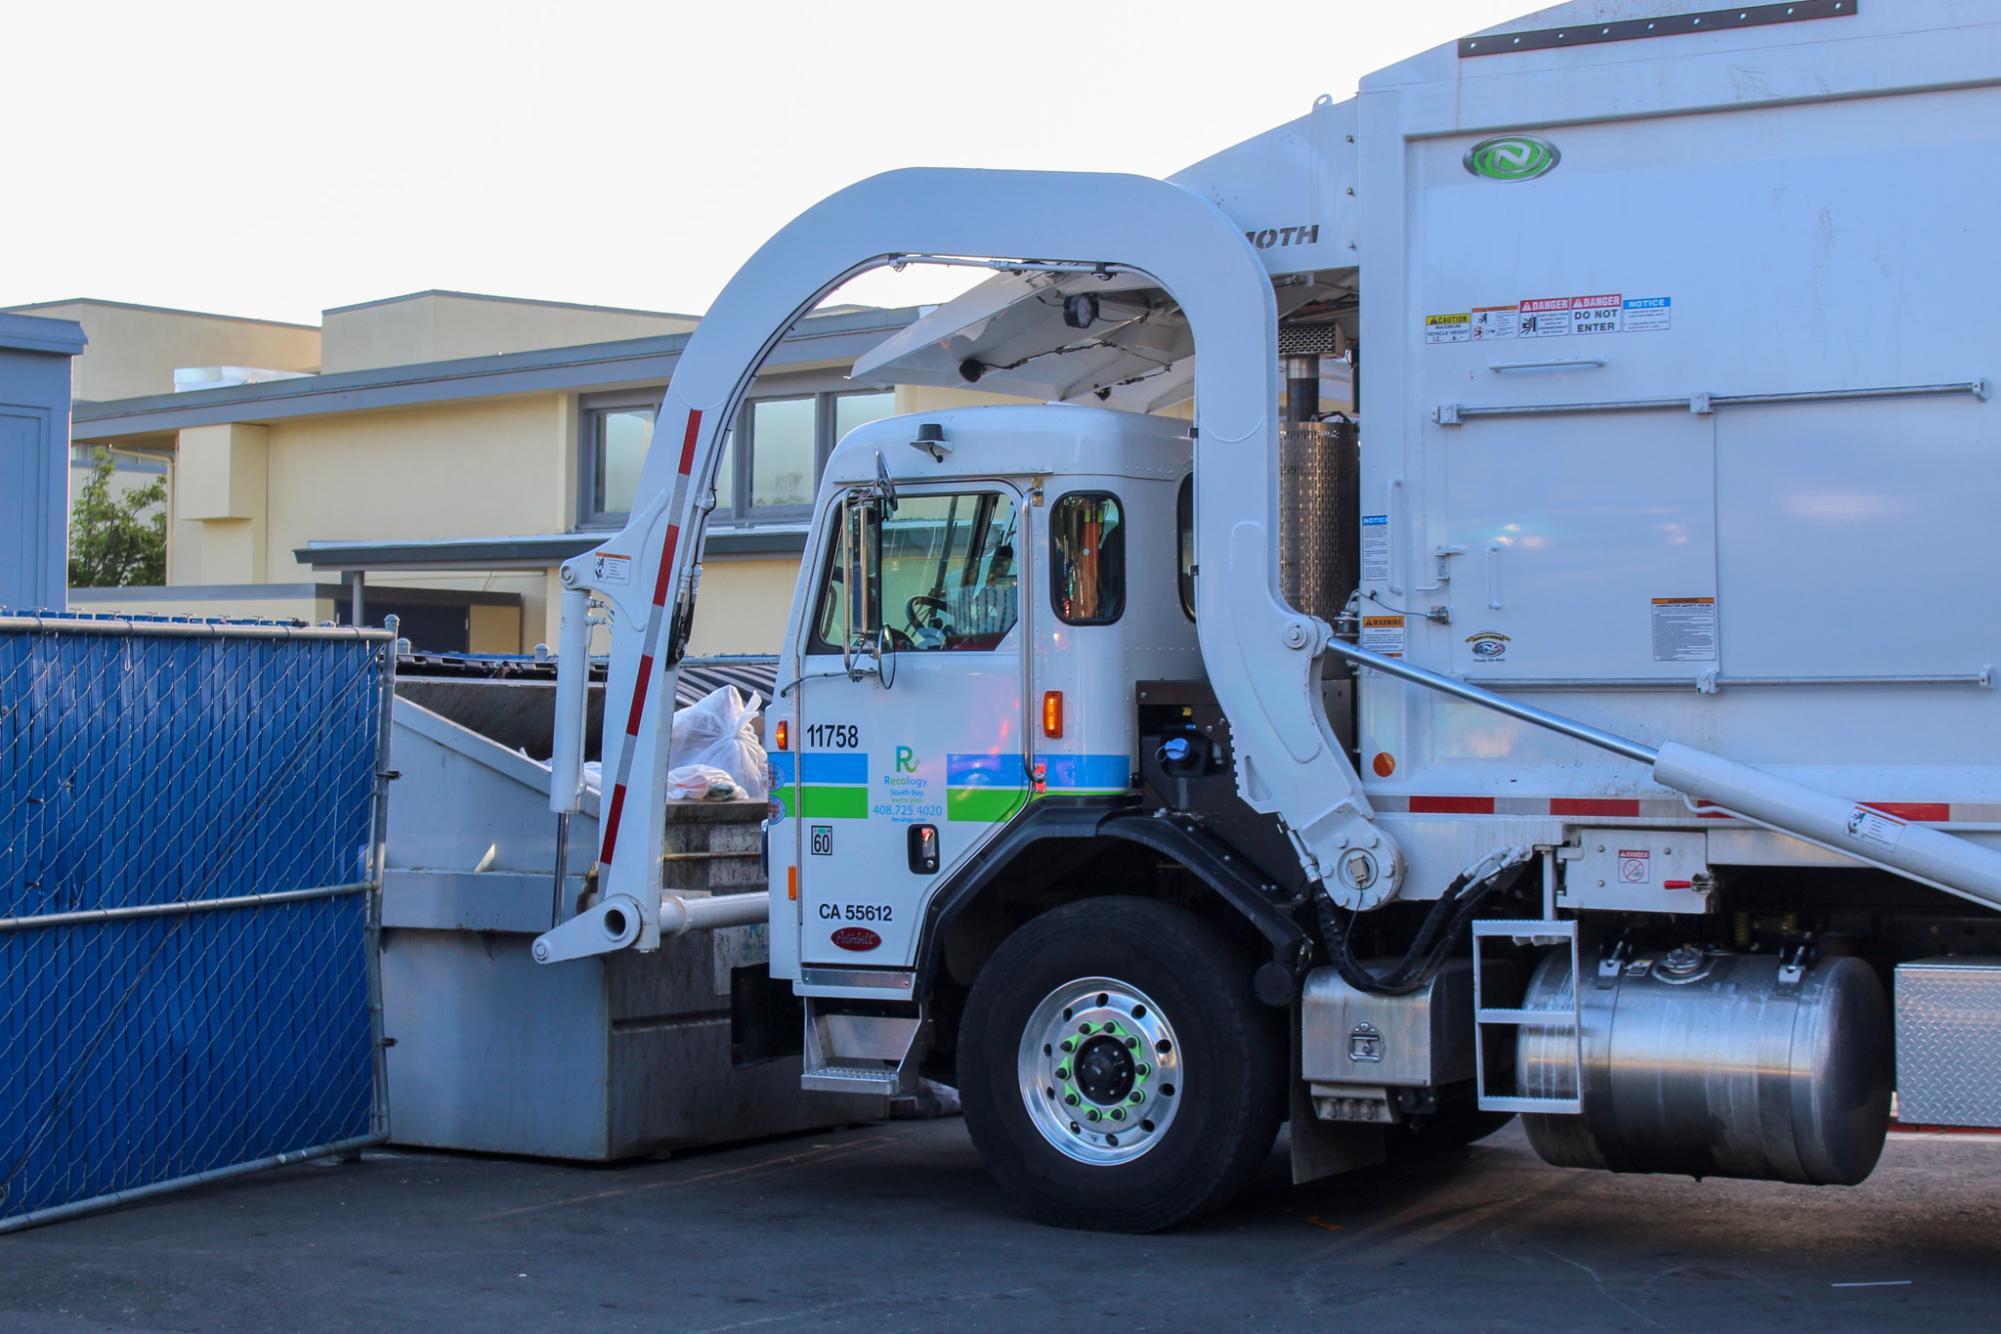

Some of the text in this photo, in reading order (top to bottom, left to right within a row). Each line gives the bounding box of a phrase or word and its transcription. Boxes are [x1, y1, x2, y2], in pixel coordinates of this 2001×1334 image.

[1532, 299, 1569, 311] DANGER
[1583, 295, 1620, 307] DANGER
[1627, 298, 1665, 308] NOTICE
[1438, 314, 1467, 324] CAUTION
[1574, 309, 1618, 320] DO NOT
[1577, 322, 1615, 333] ENTER
[807, 724, 859, 748] 11758
[884, 776, 928, 788] Recology
[912, 789, 924, 797] Bay
[873, 805, 943, 816] 408.725.4020
[814, 834, 830, 852] 60
[819, 903, 893, 922] CA 55612
